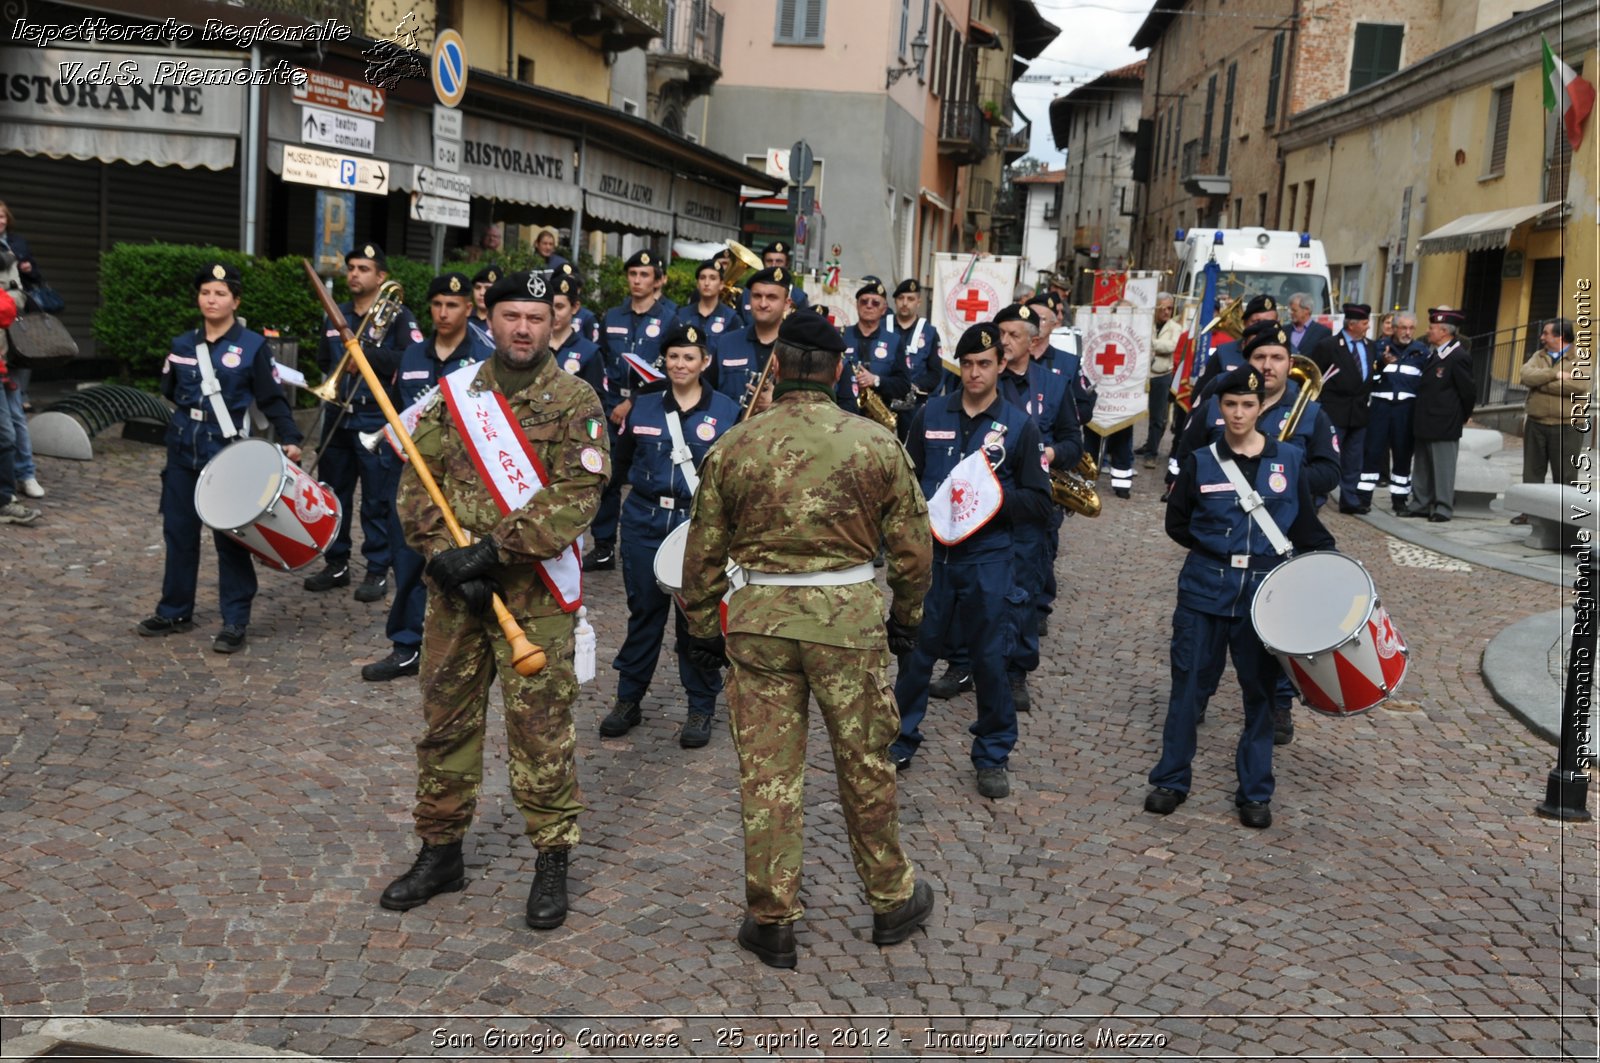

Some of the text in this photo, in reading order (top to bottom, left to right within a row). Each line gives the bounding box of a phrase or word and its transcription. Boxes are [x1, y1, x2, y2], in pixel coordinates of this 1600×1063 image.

[310, 73, 344, 90] CASTELLO
[0, 73, 204, 115] ISTORANTE
[335, 116, 358, 132] teatro
[334, 134, 372, 150] comunale
[287, 151, 339, 169] MUSEO CIVICO
[463, 140, 564, 180] RISTORANTE
[436, 176, 471, 197] municipio
[1100, 391, 1130, 399] AZIONE
[1096, 404, 1127, 413] AVENO
[475, 403, 530, 495] INTER ARMA
